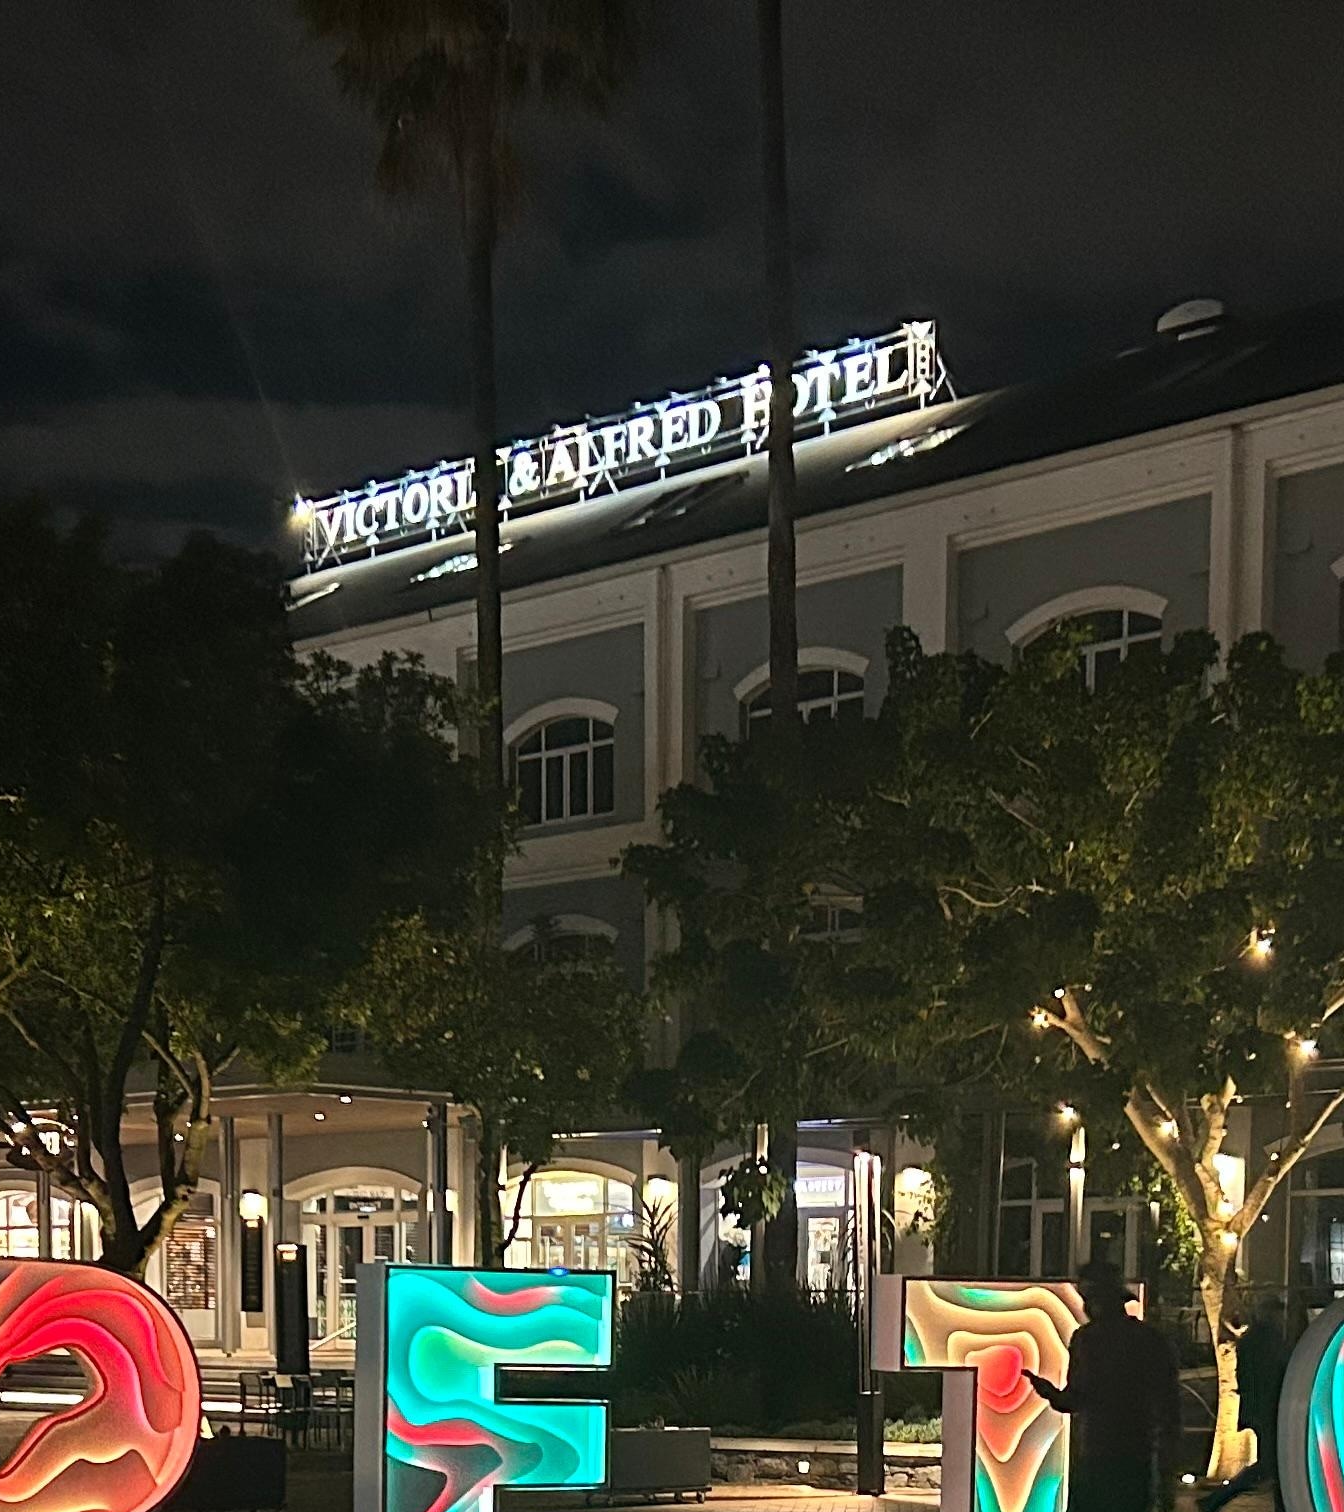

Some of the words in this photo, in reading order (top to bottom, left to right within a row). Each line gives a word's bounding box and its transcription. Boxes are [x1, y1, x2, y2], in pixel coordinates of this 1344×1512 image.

[316, 469, 478, 547] VICTORI
[508, 450, 541, 496] &
[546, 398, 722, 486] ALFRED
